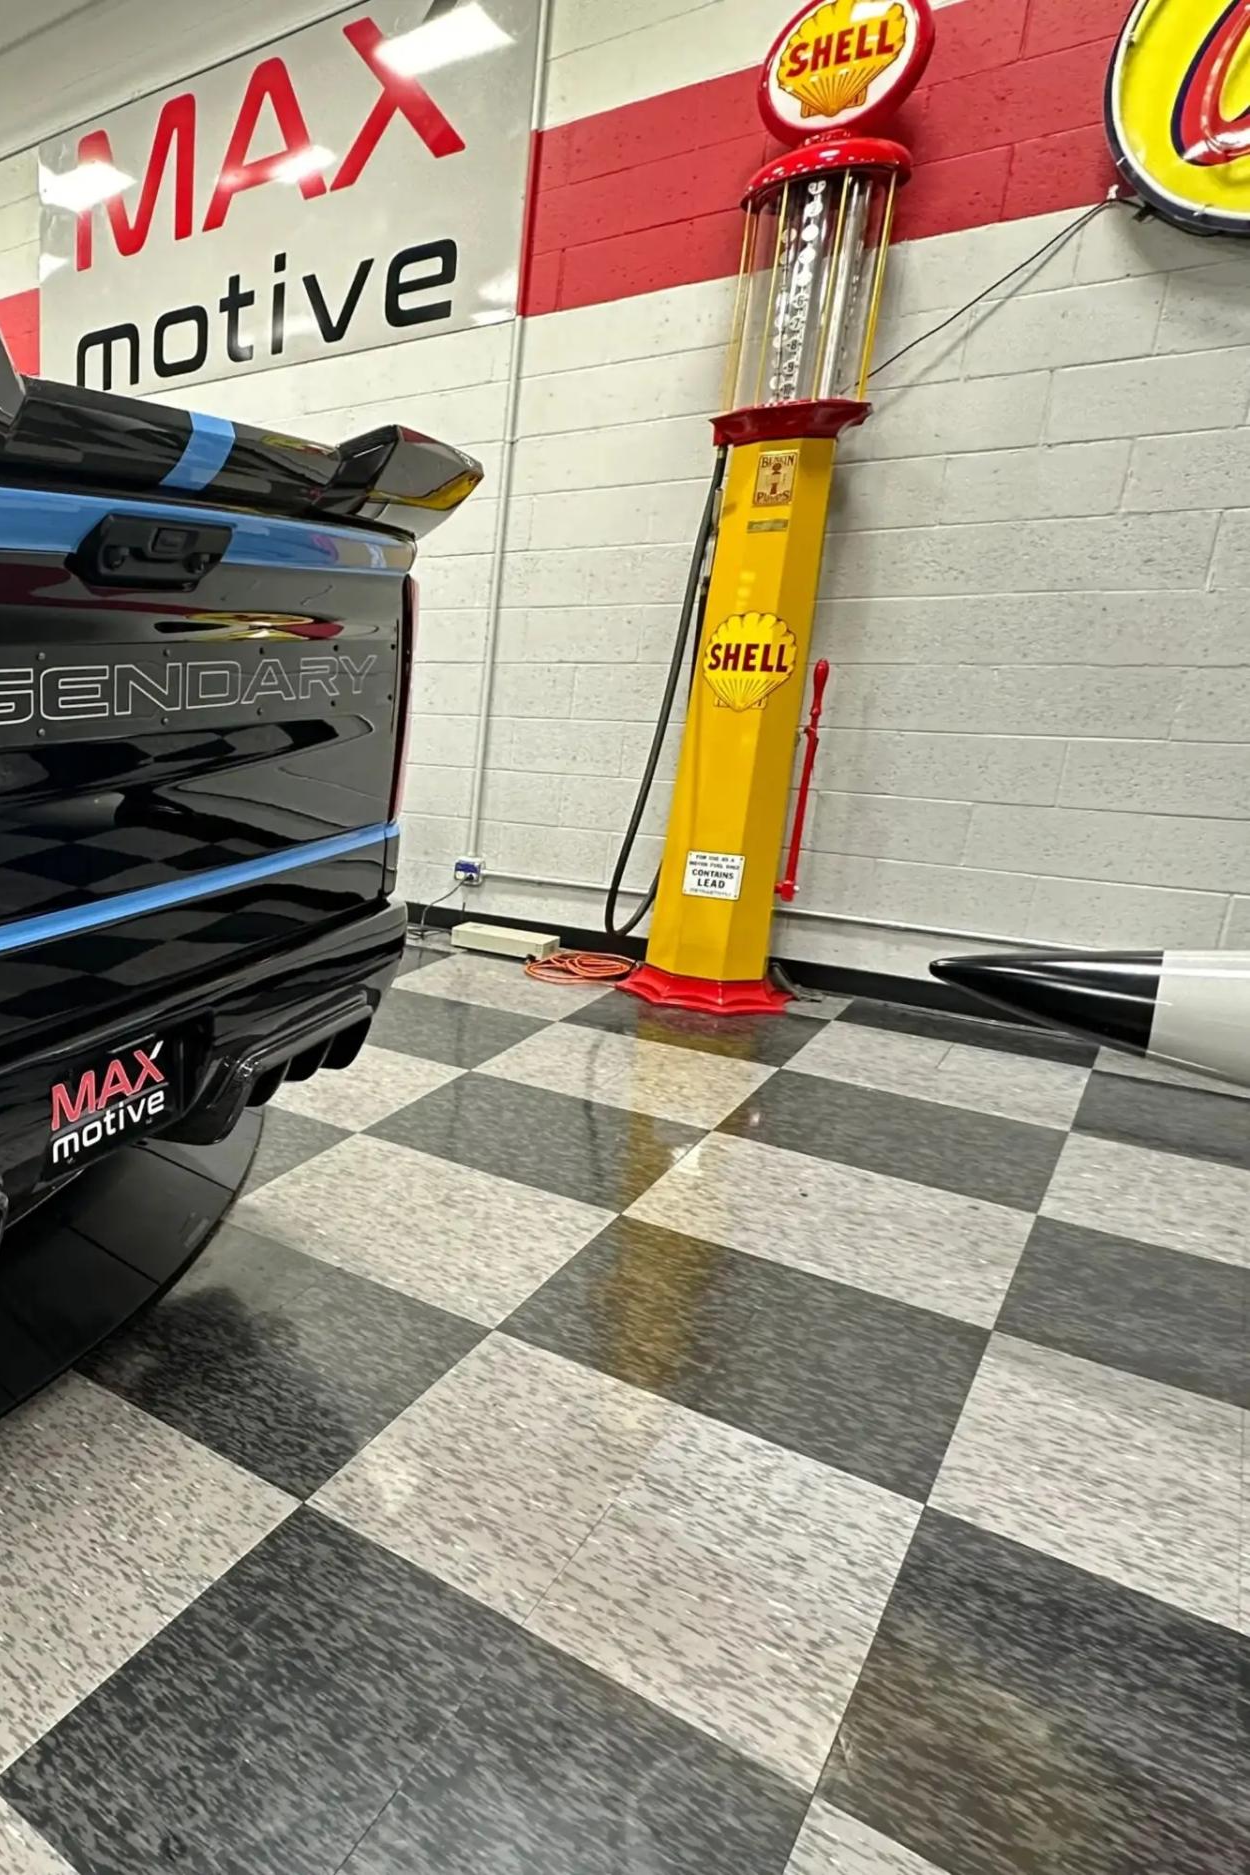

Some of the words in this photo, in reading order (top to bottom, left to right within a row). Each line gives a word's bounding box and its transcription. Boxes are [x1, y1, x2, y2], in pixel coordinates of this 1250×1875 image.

[786, 20, 894, 77] SHELL
[76, 8, 466, 272] MAX
[76, 238, 457, 390] motive
[708, 643, 788, 673] SHELL
[692, 868, 734, 880] CONTAINS
[697, 878, 726, 889] LEAD
[51, 1040, 165, 1131] MAX
[52, 1090, 166, 1164] motive
